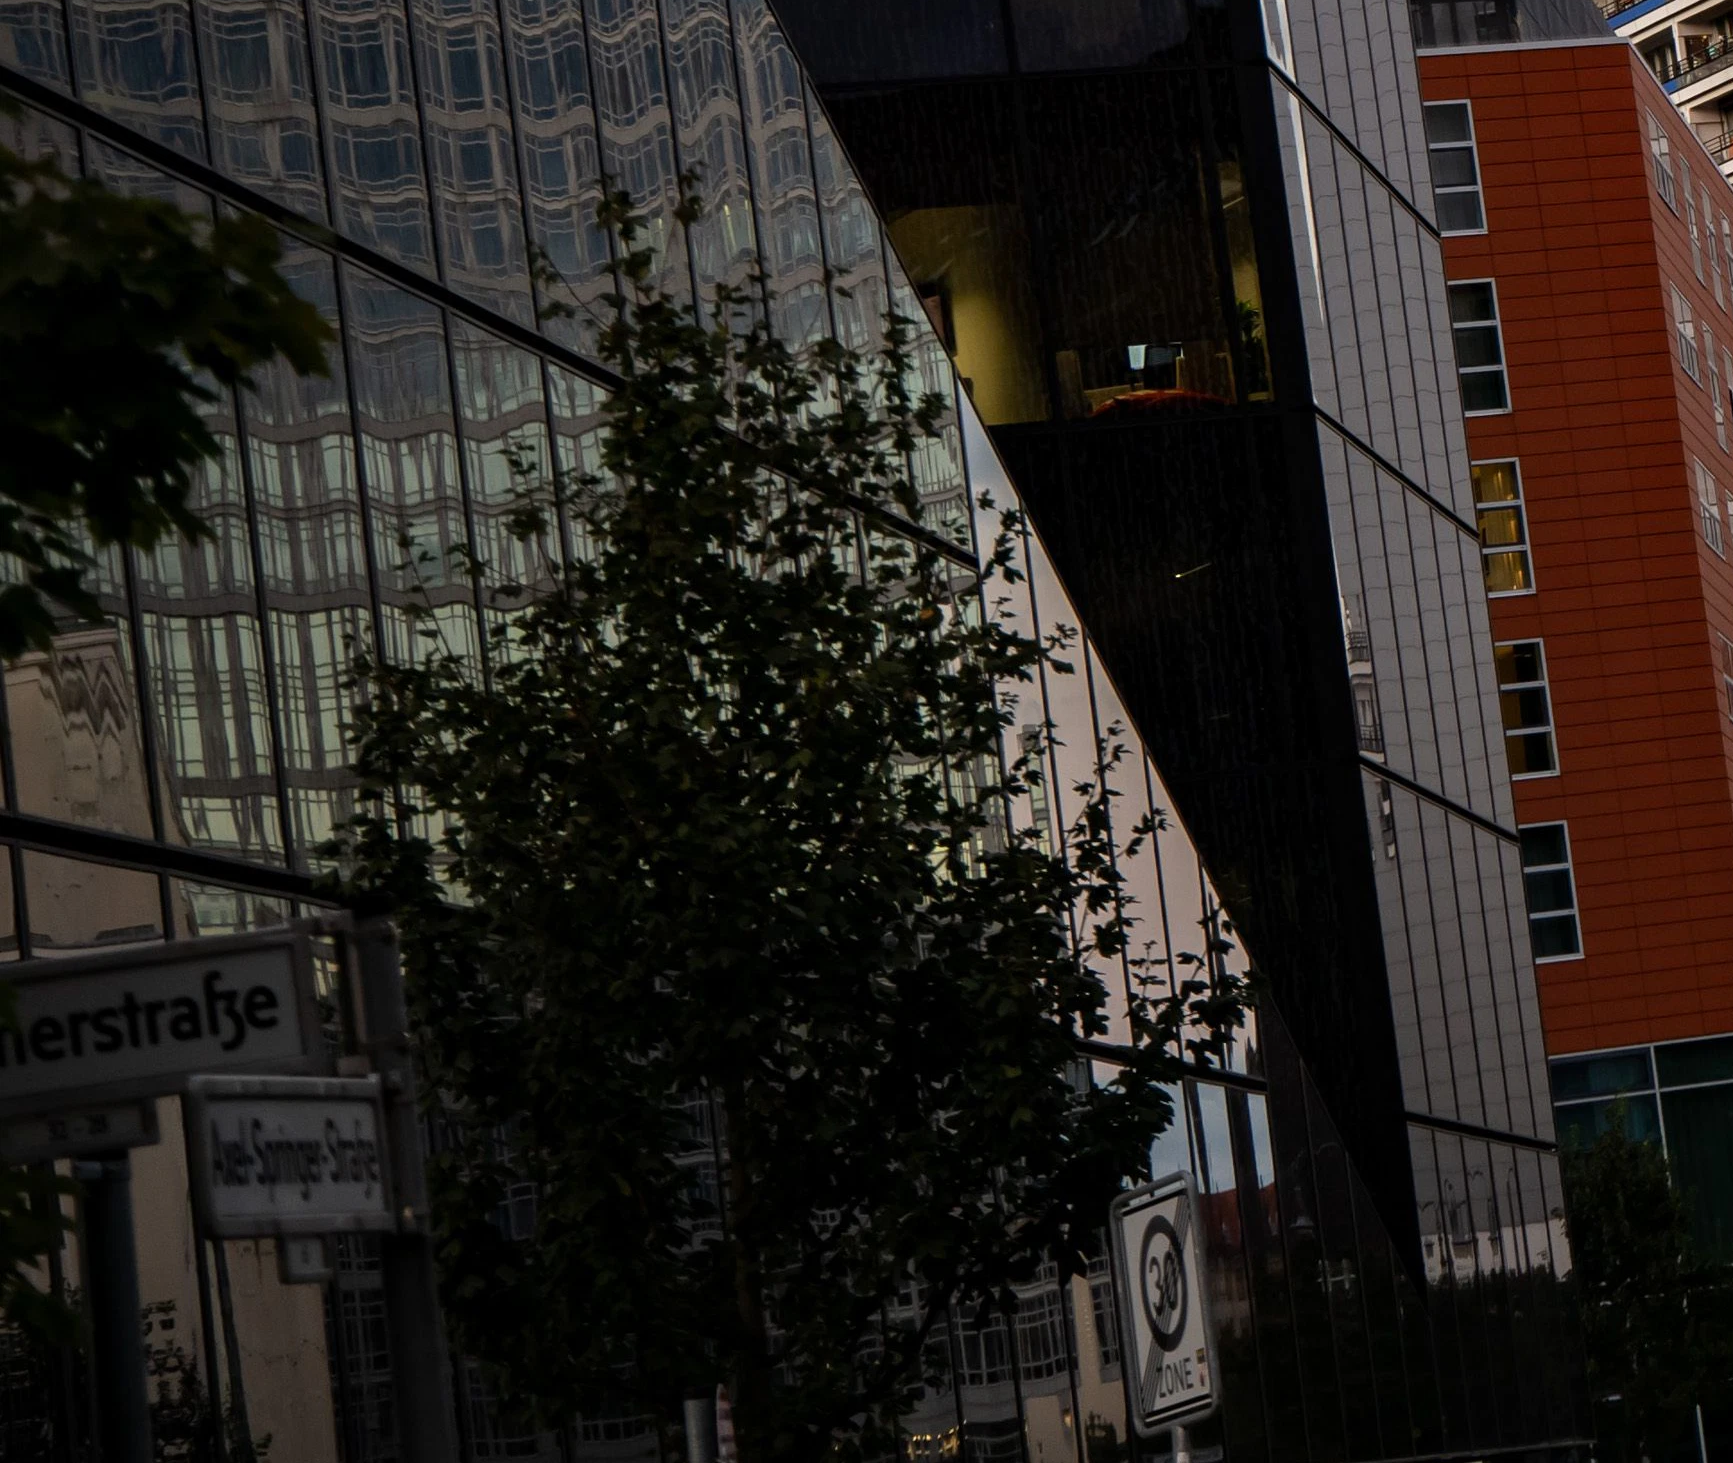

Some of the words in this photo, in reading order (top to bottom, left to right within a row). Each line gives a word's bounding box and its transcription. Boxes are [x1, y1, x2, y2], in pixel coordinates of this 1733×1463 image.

[210, 1117, 379, 1202] Axel-Springer-Straße
[1148, 1253, 1180, 1316] 30
[1156, 1356, 1194, 1399] ZONE
